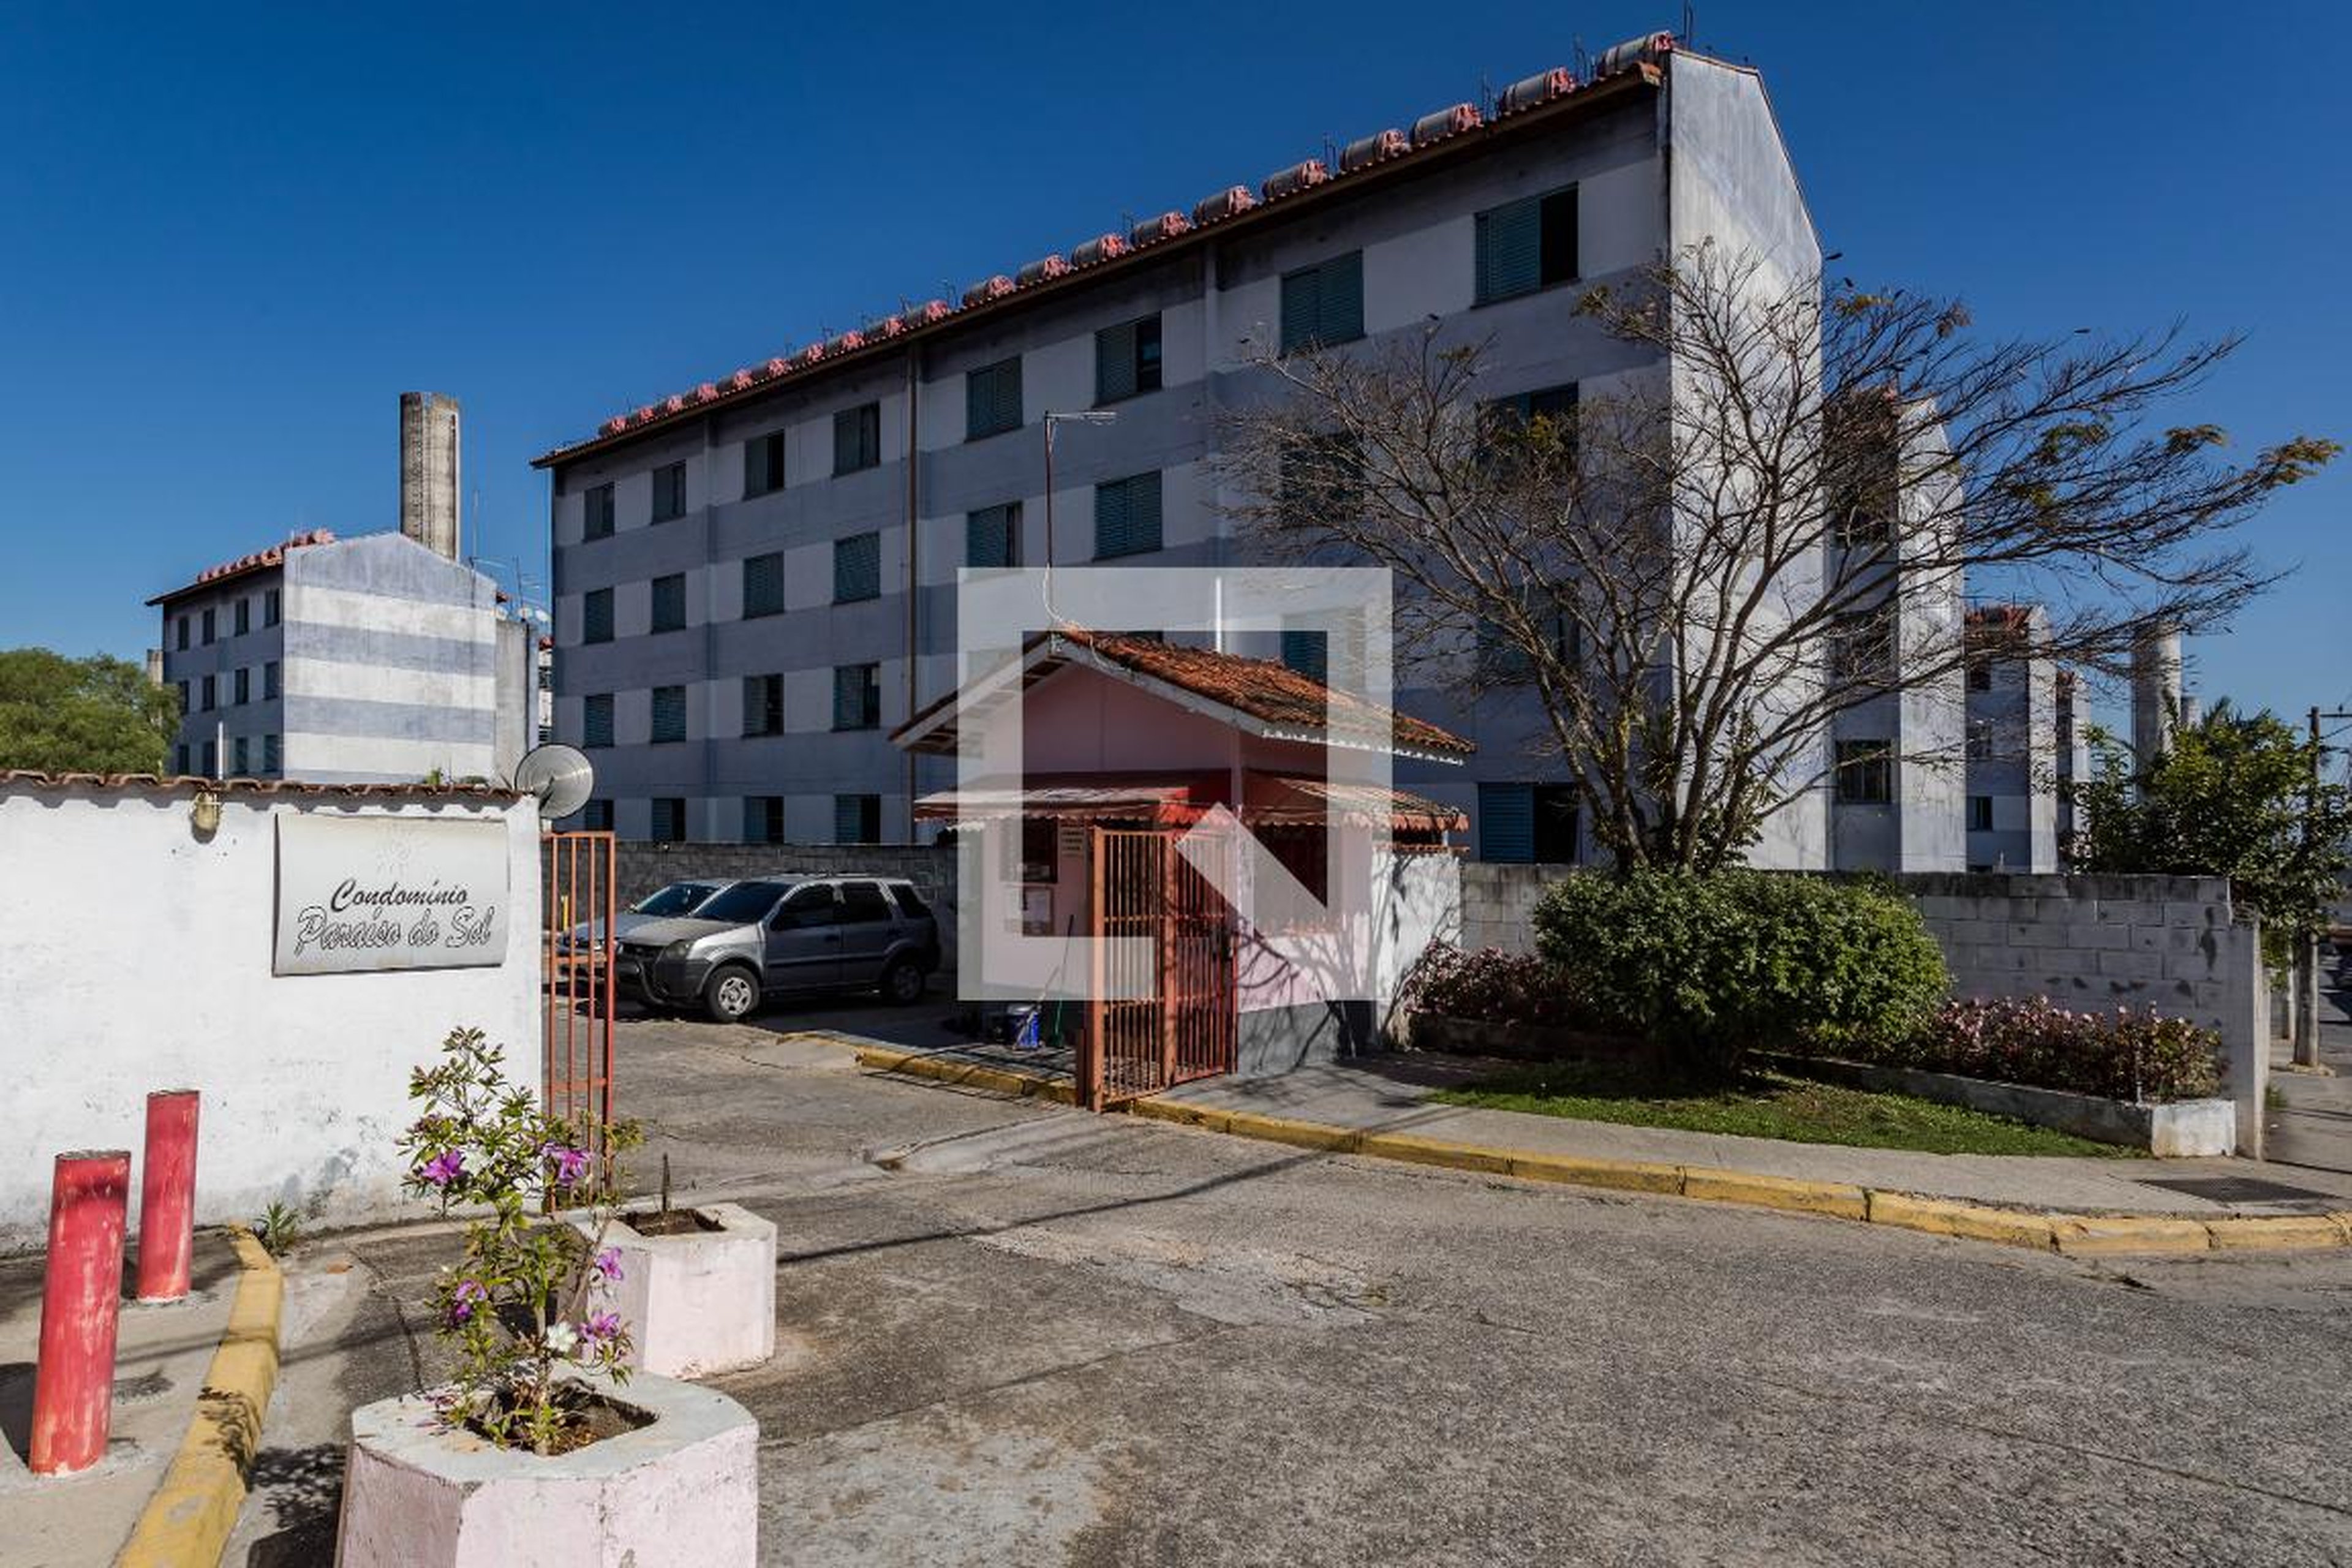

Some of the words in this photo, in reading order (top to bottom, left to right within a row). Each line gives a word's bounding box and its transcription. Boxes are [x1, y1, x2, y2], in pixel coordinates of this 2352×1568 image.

[330, 878, 469, 913] Condomínio
[294, 905, 402, 956] Paraíso
[407, 908, 439, 948] do
[445, 905, 495, 948] Sol
